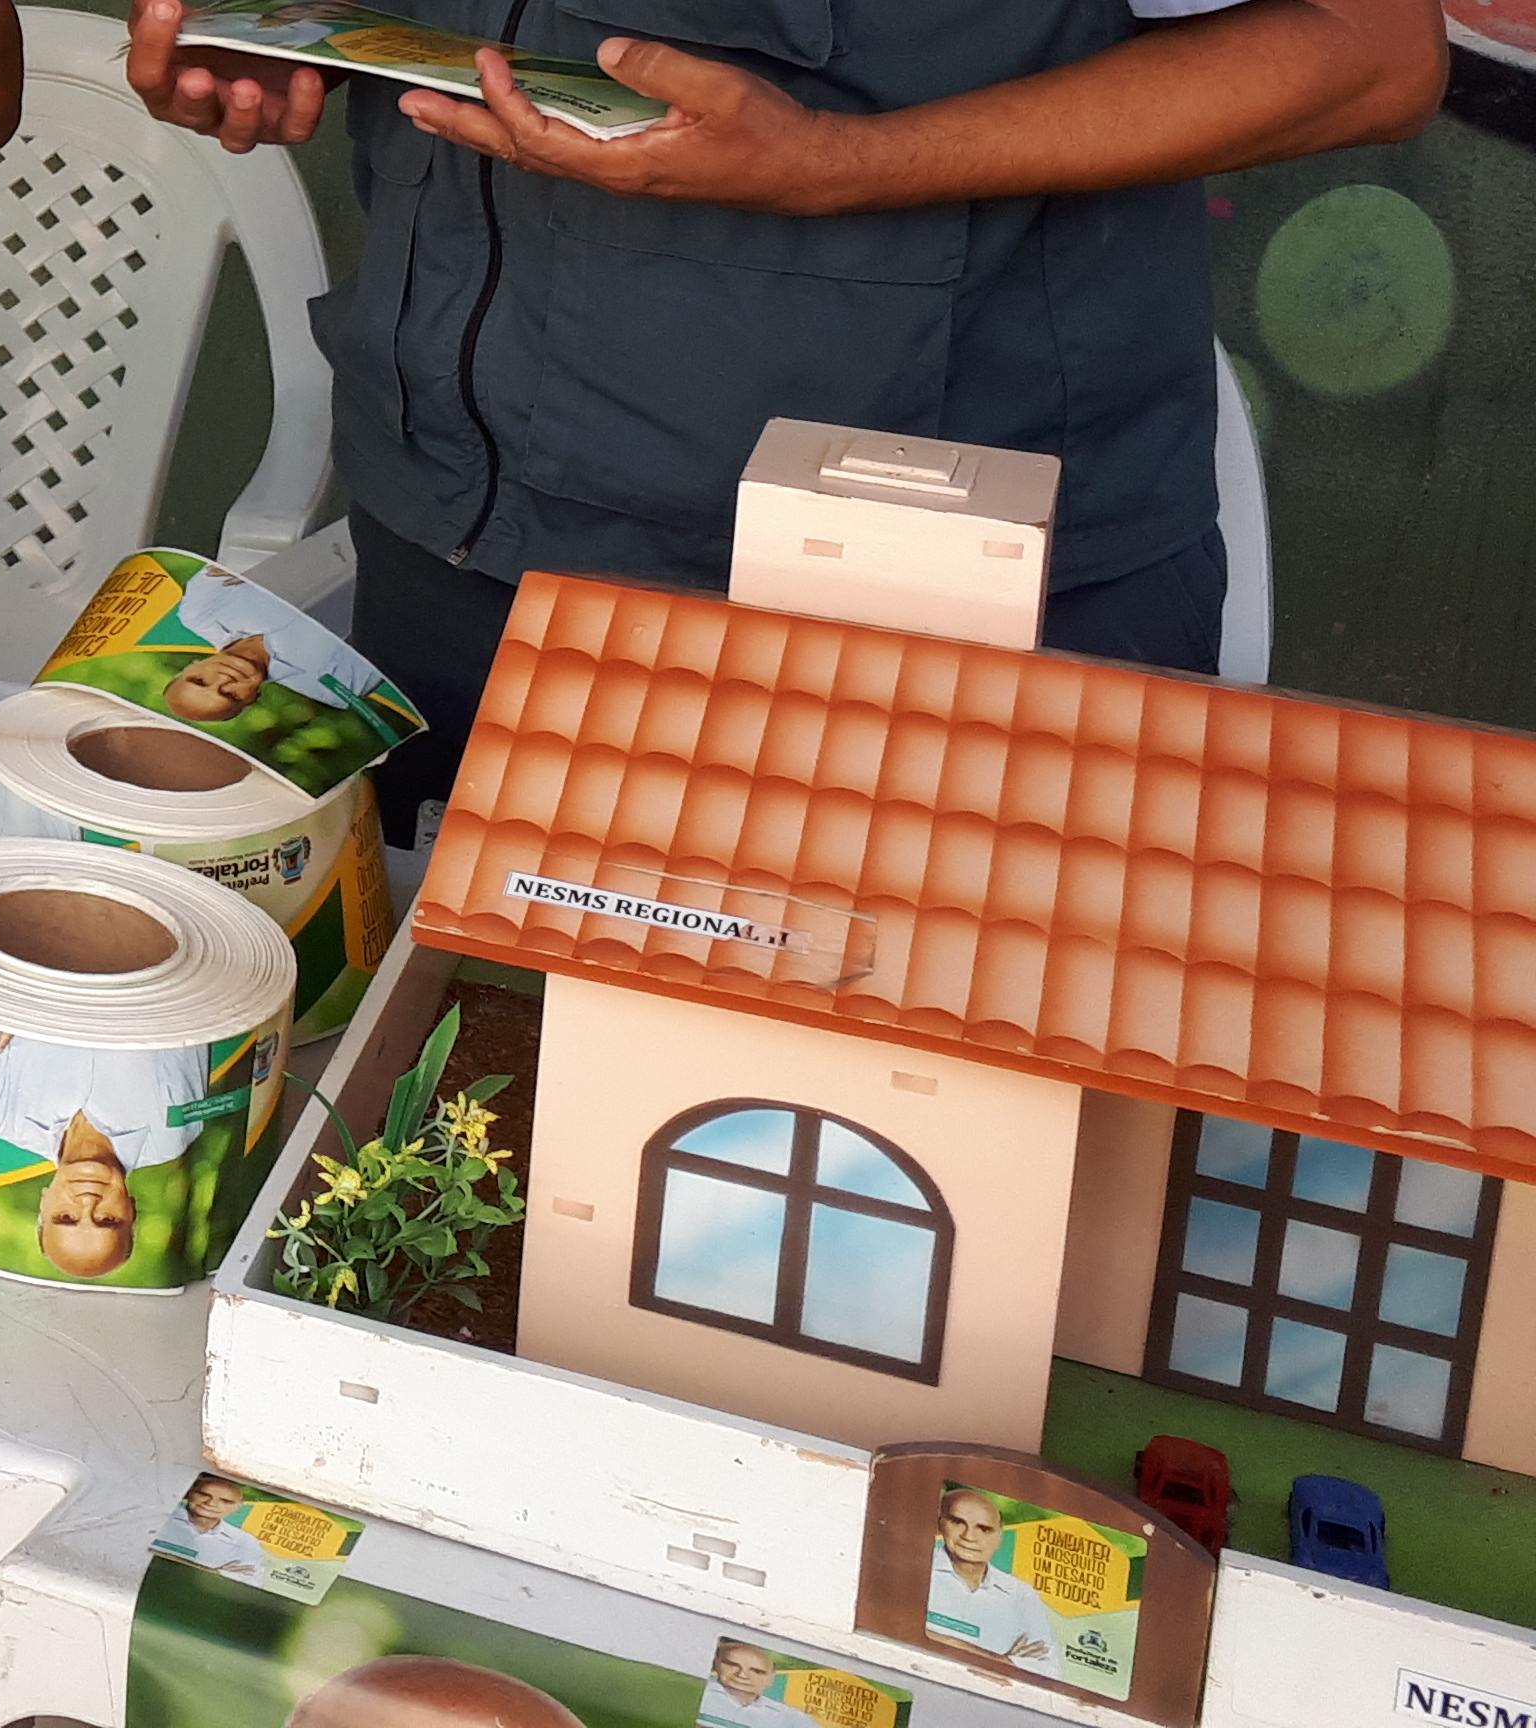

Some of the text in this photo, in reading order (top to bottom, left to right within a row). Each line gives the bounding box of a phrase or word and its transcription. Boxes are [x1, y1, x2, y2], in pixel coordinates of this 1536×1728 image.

[512, 877, 760, 942] NESMS REGIONAL
[1032, 1541, 1107, 1576] O MOSQUITO
[1032, 1557, 1052, 1575] UM
[1032, 1573, 1051, 1596] DE
[1403, 1680, 1536, 1728] NESM
